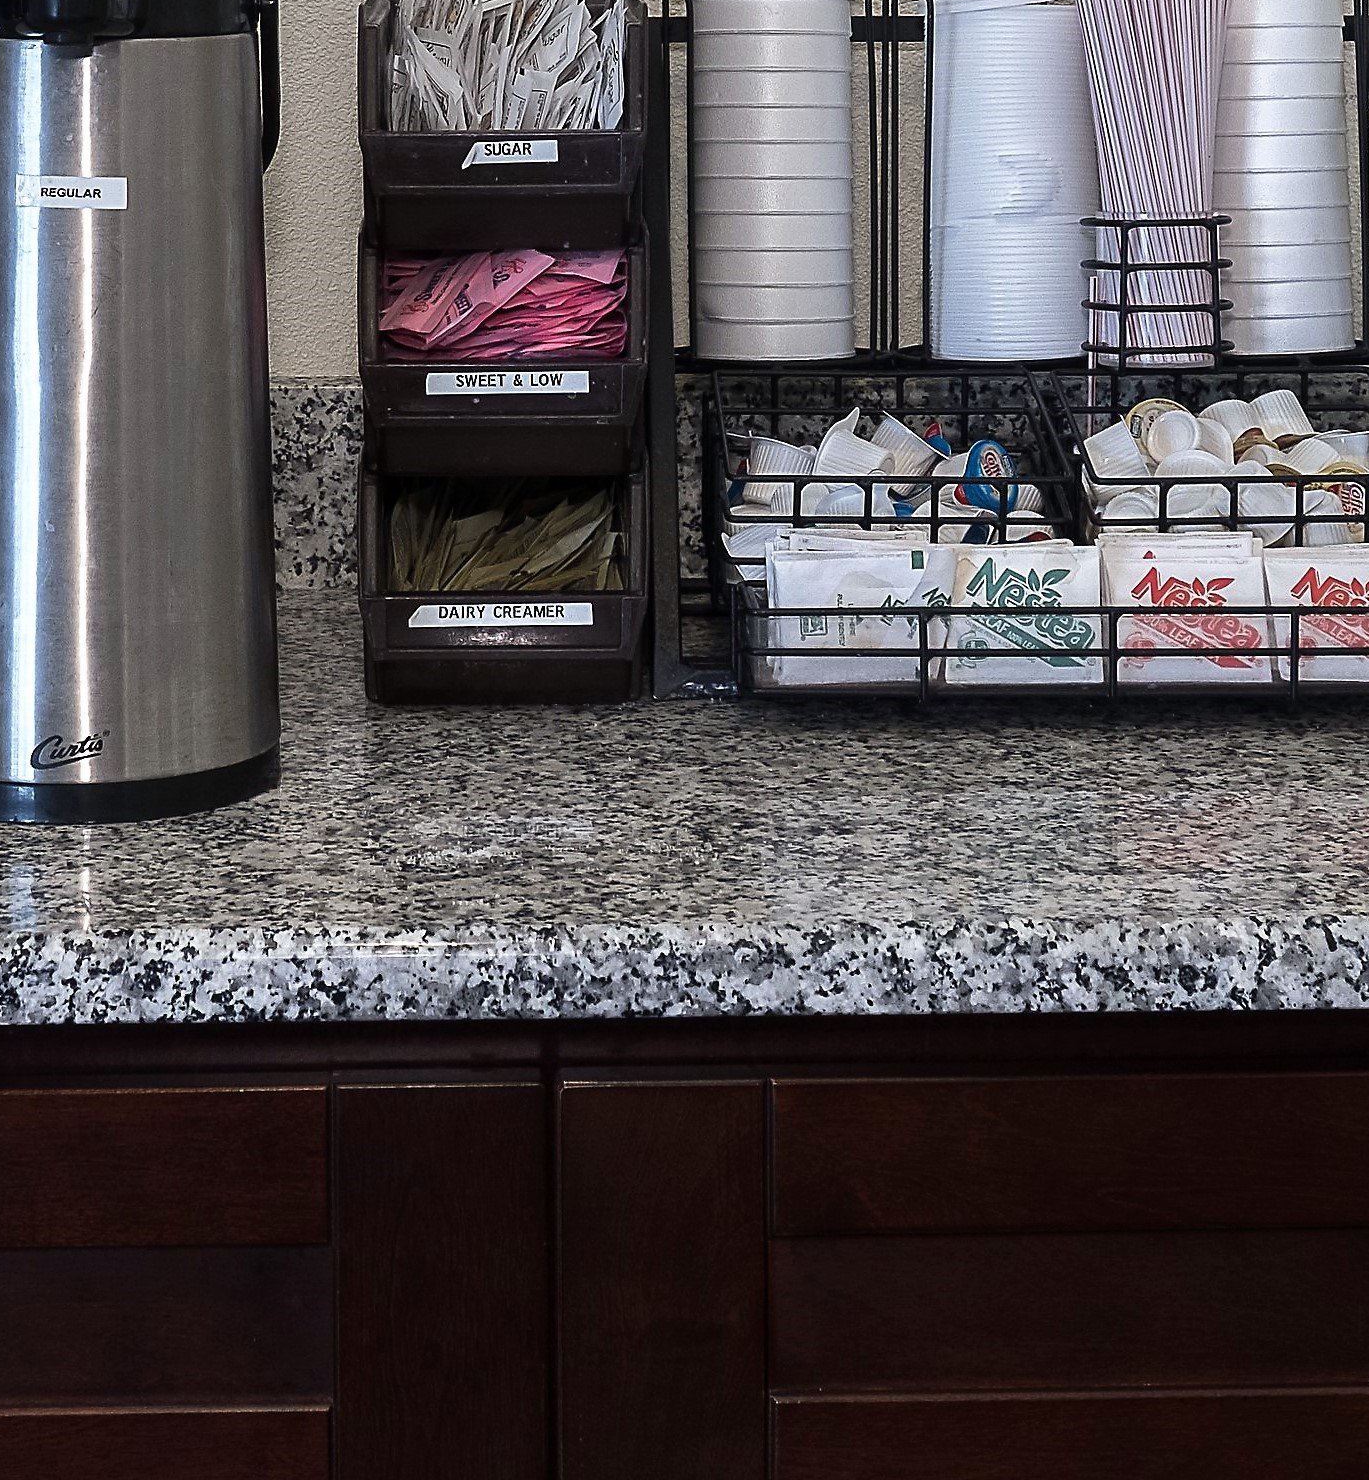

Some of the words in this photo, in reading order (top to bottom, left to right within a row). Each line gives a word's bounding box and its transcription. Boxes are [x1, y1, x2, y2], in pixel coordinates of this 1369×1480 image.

[484, 143, 532, 156] SUGAR
[40, 187, 102, 198] REGULAR
[455, 374, 506, 387] SWEET
[513, 373, 523, 387] &
[530, 373, 563, 386] LOW
[438, 606, 485, 619] DAIRY
[493, 605, 564, 618] CREAMER
[30, 733, 104, 770] Curtis
